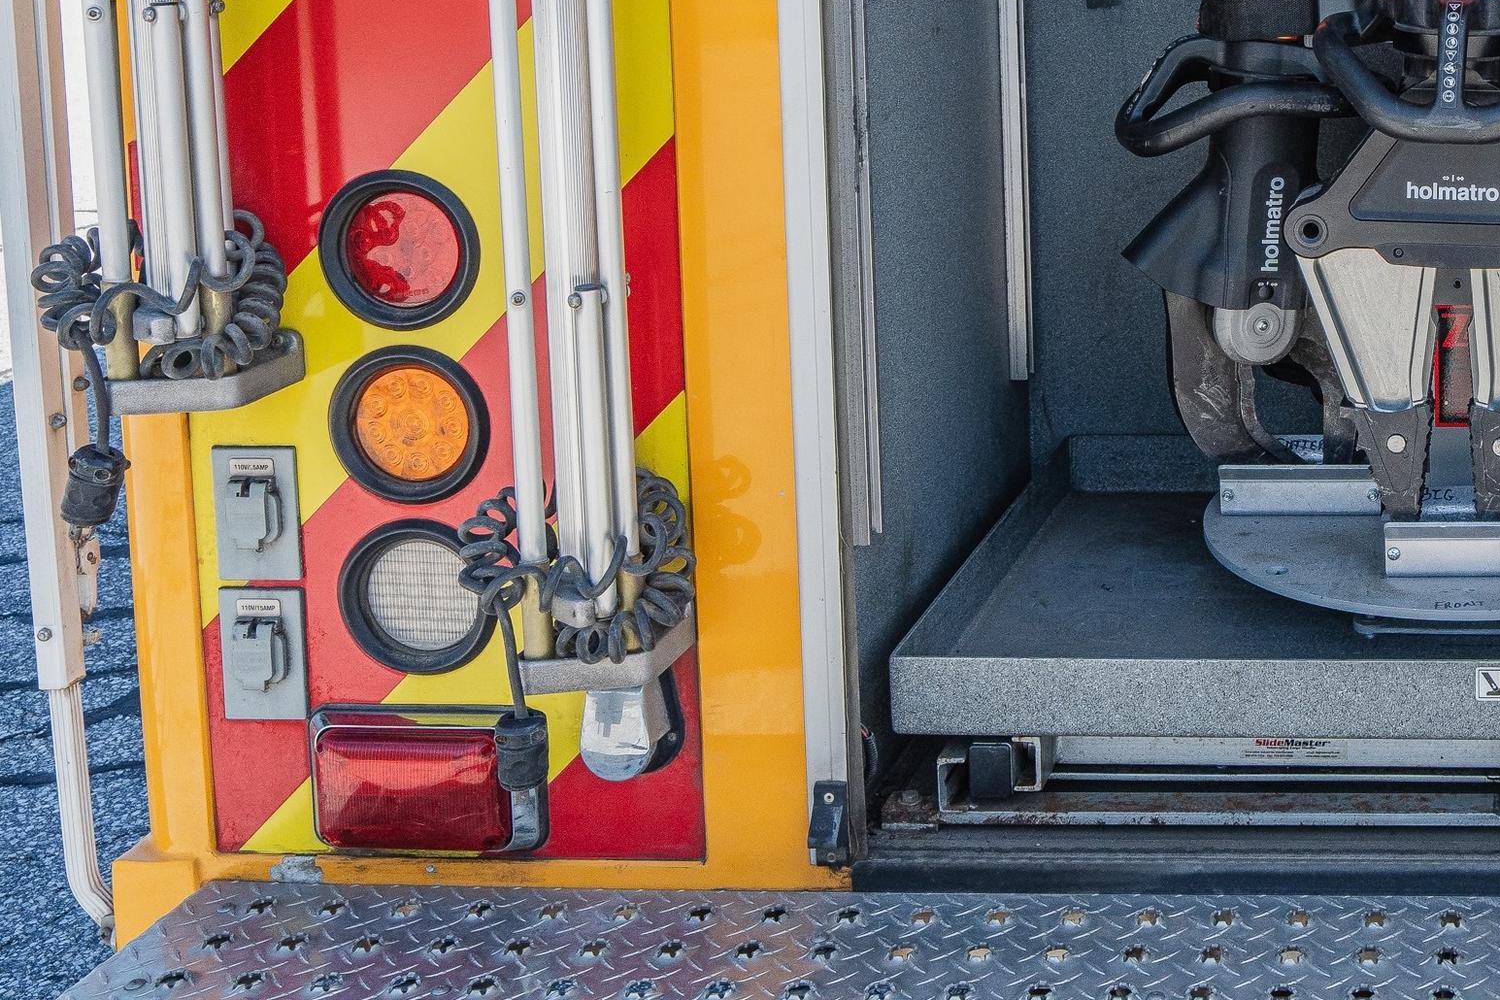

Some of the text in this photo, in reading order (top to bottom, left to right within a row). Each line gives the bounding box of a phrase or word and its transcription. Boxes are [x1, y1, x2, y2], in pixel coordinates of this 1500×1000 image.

[1406, 181, 1500, 202] holmatro
[1260, 176, 1285, 272] holmatro
[1433, 600, 1484, 610] FRONT
[1255, 738, 1329, 747] SlideMaster
